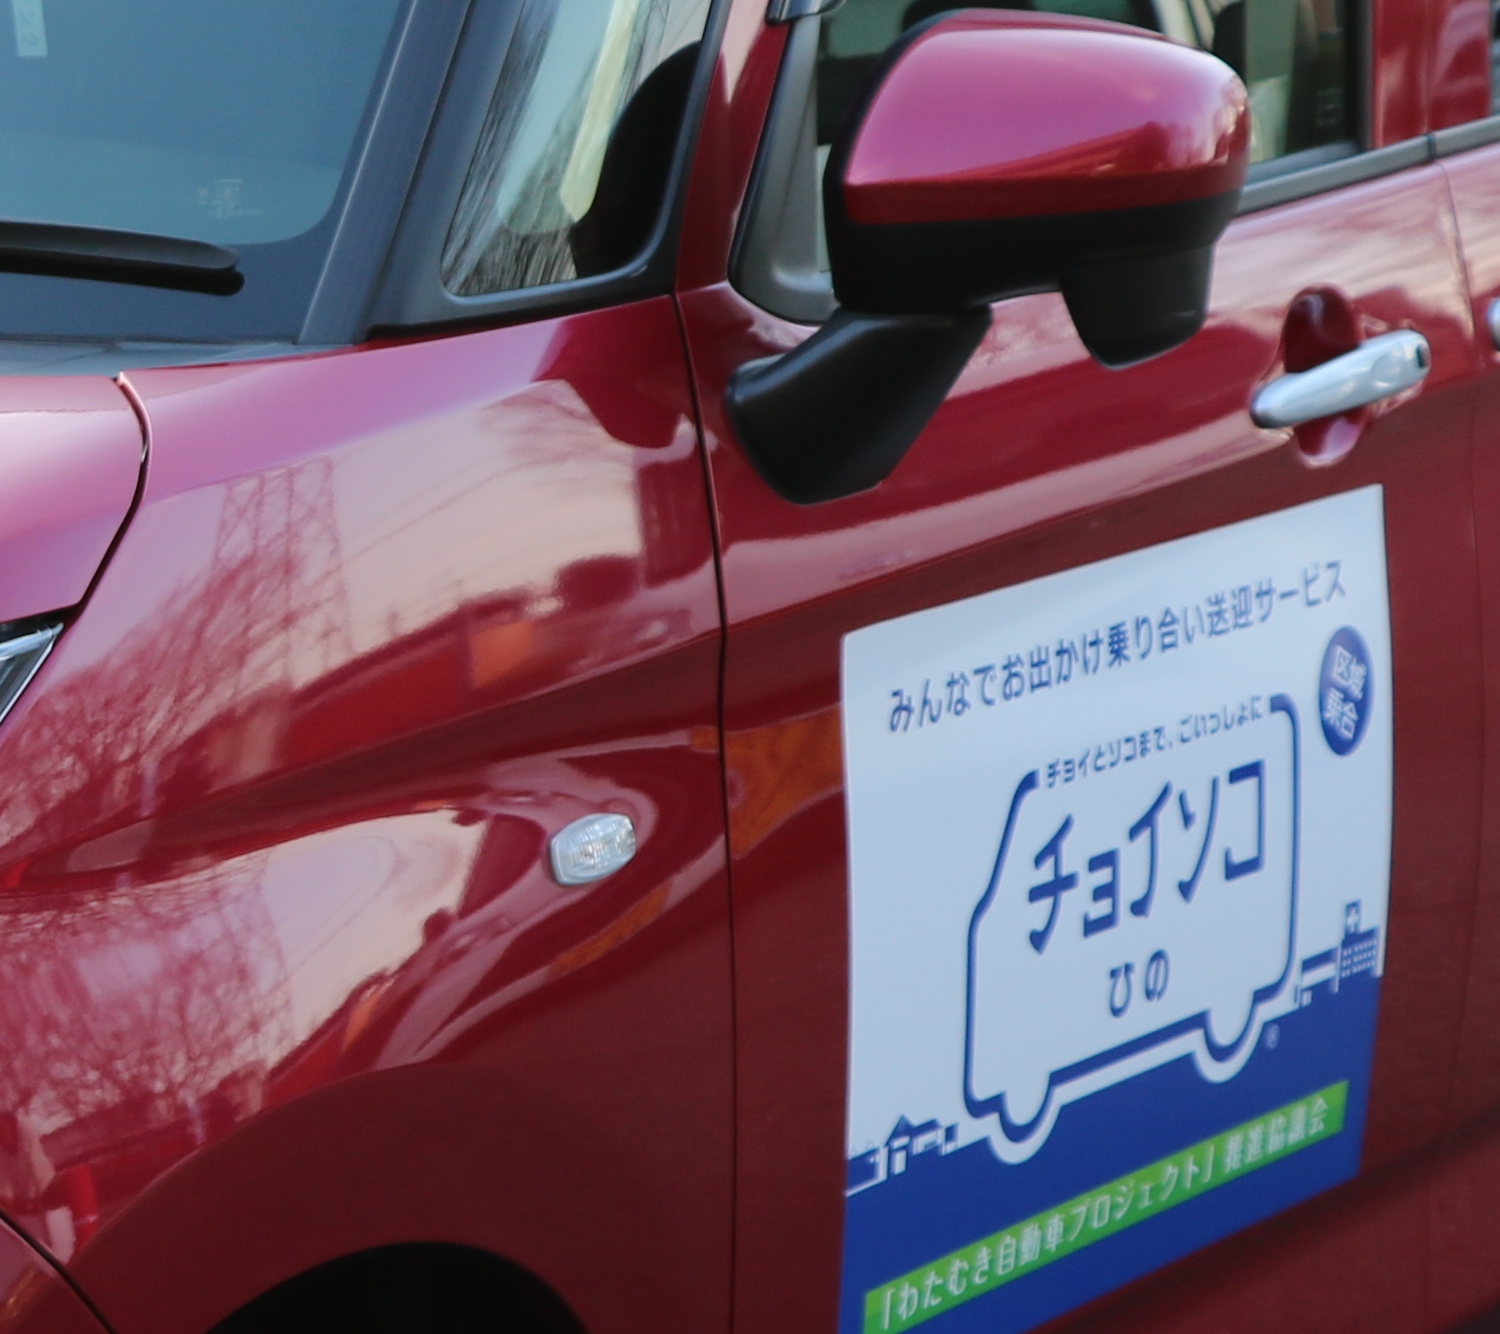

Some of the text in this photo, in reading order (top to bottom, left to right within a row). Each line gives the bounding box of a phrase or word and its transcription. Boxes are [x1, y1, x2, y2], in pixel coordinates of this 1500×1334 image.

[889, 560, 1347, 734] みんなでお出かけ乗り合い送迎サービス
[1028, 759, 1266, 955] チョイソコ
[1109, 948, 1170, 1018] ひの
